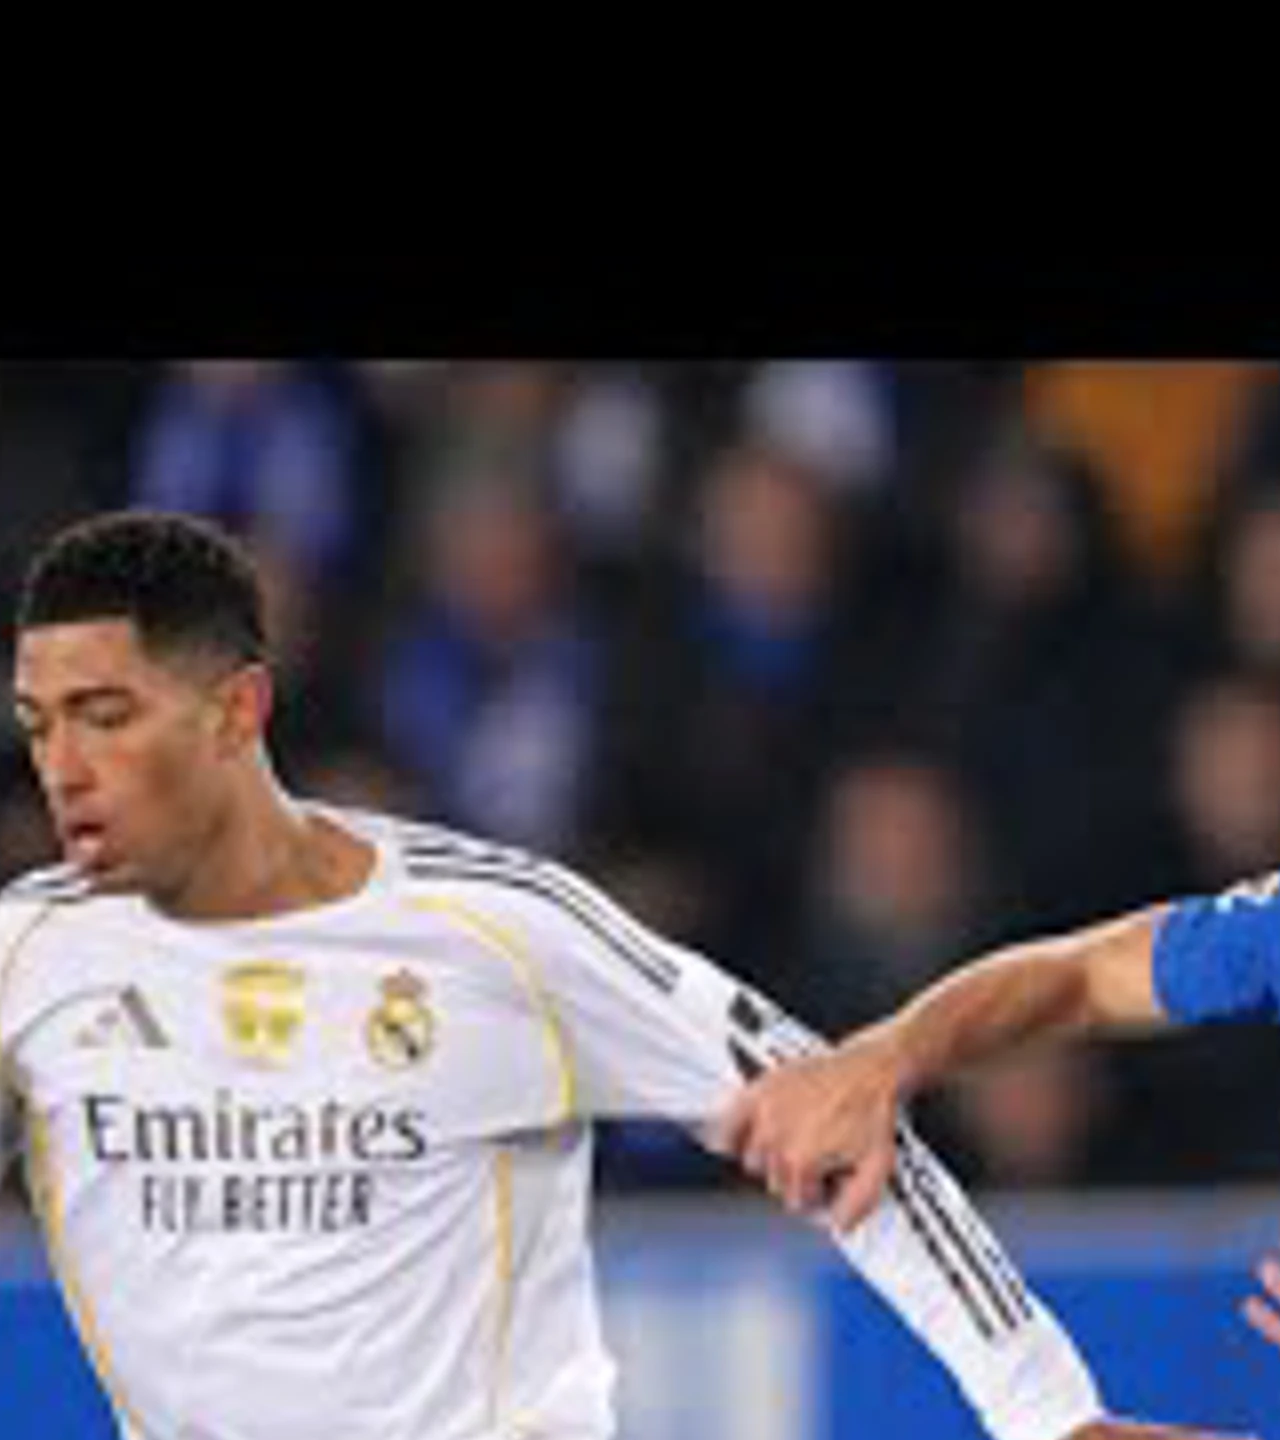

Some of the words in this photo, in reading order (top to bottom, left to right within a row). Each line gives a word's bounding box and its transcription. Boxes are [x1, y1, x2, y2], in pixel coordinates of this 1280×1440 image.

[84, 1090, 428, 1163] Emirates
[142, 1174, 200, 1234] FLY
[221, 1171, 372, 1232] BETTER
